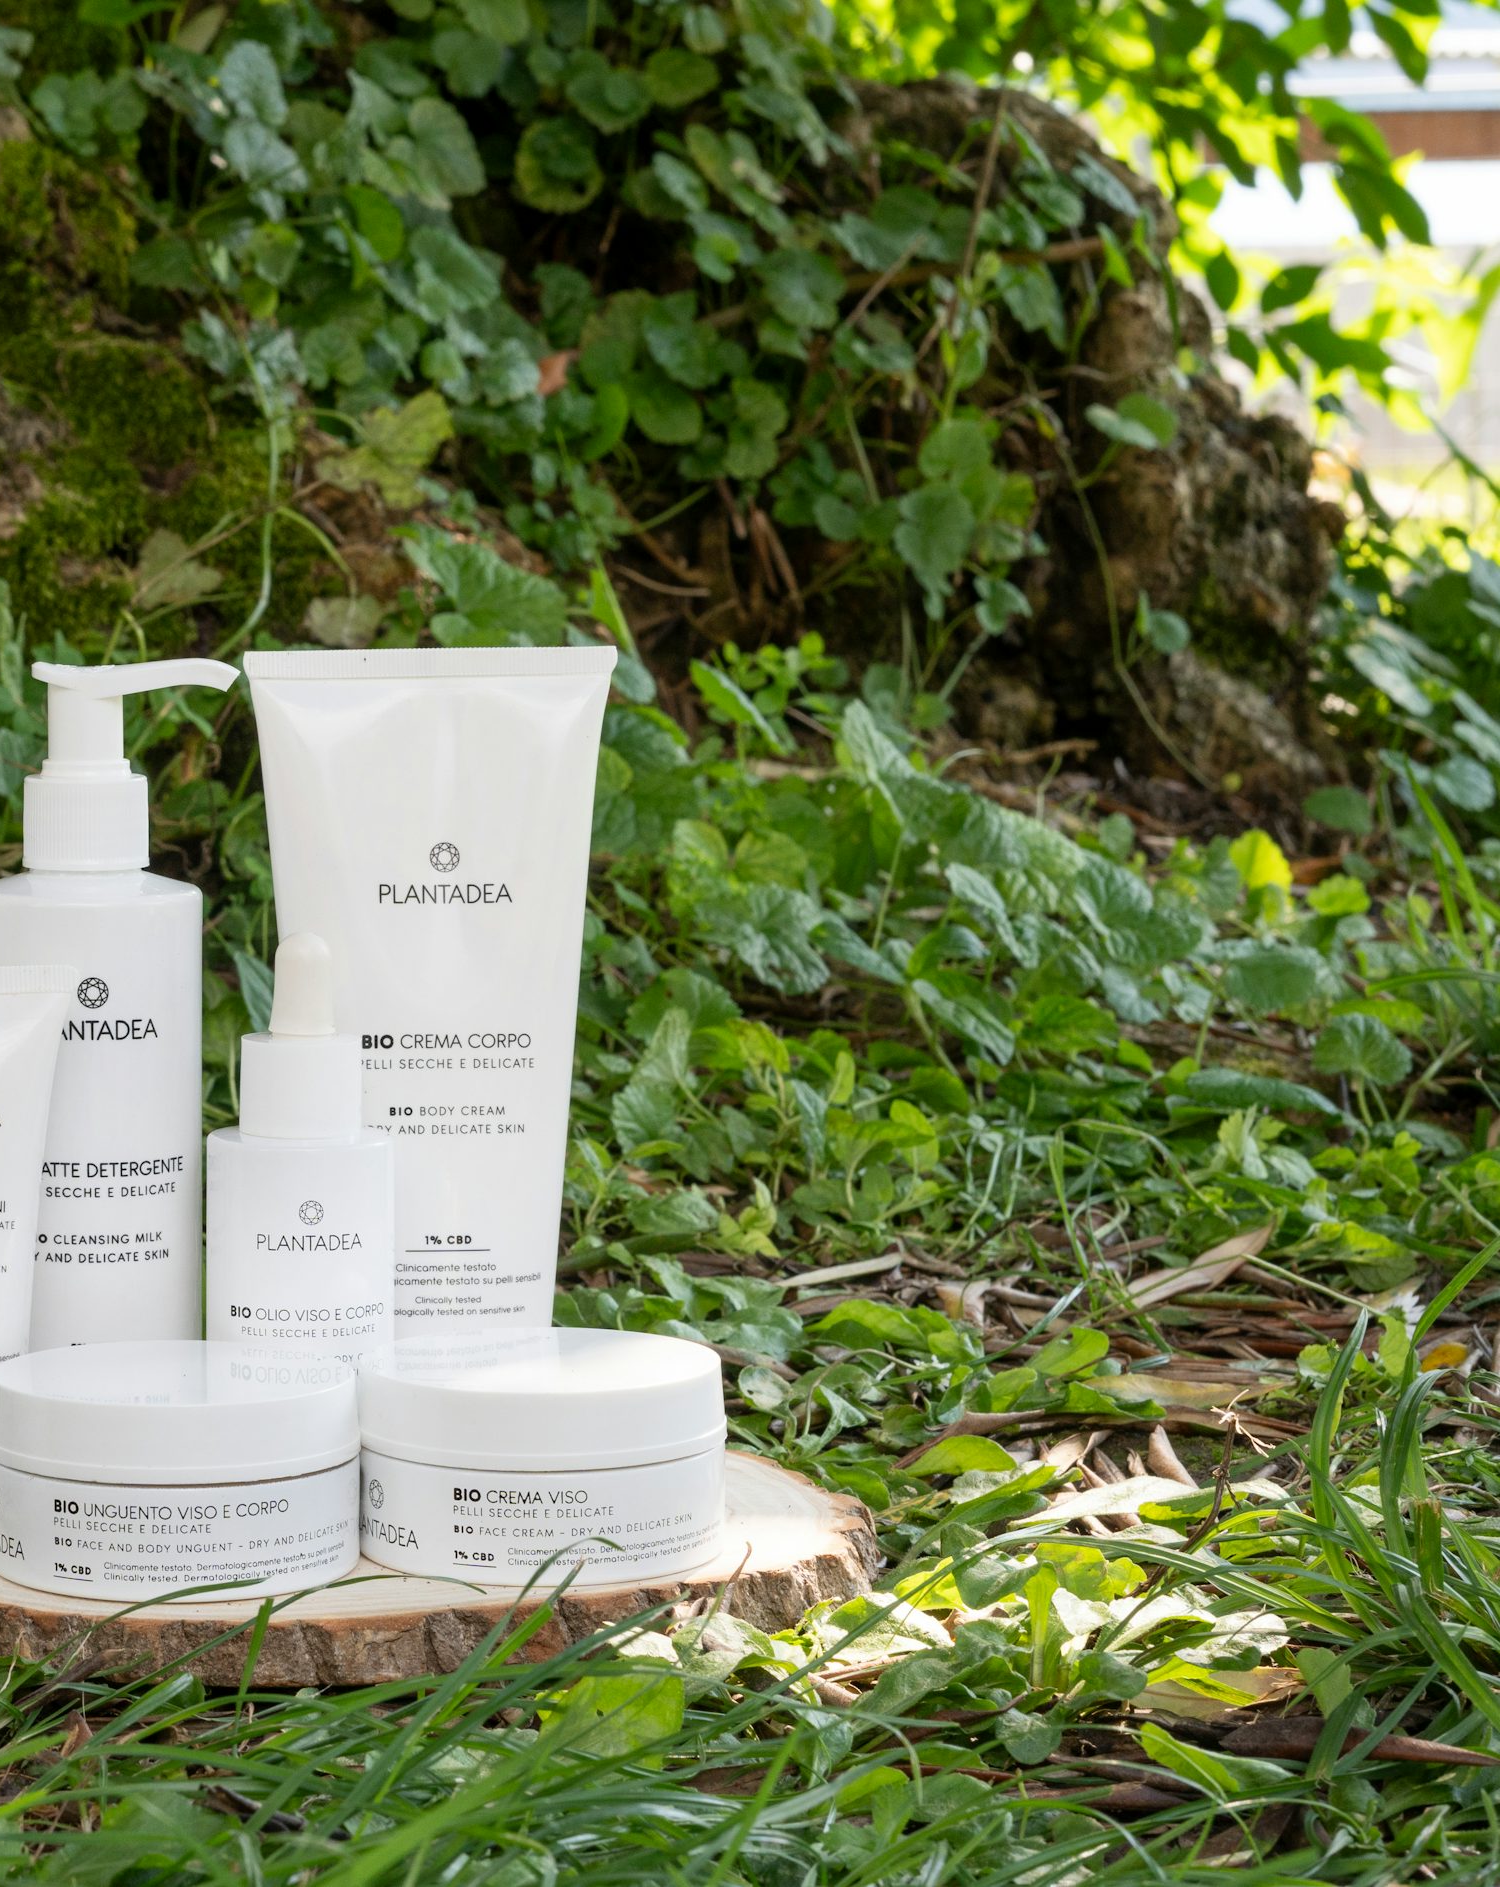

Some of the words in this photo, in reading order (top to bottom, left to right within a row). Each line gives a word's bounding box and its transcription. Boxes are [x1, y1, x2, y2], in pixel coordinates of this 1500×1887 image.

[379, 884, 512, 904] PLANTADEA
[362, 1035, 394, 1049] BIO
[400, 1034, 462, 1049] CREMA
[468, 1033, 531, 1049] CORPO
[399, 1058, 453, 1070] SECCHE
[460, 1059, 466, 1068] E
[473, 1058, 535, 1069] DELICATE
[389, 1107, 413, 1116] BIO
[419, 1106, 455, 1116] BODY
[461, 1106, 505, 1115] CREAM
[398, 1125, 425, 1135] AND
[432, 1125, 491, 1135] DELICATE
[497, 1124, 525, 1134] SKIN
[42, 1162, 80, 1177] ATTE
[87, 1156, 183, 1178] DETERGENTE
[46, 1187, 100, 1198] SECCHE
[108, 1187, 114, 1197] E
[121, 1182, 176, 1197] DELICATE
[53, 1234, 130, 1245] CLEANSING
[135, 1232, 162, 1243] MILK
[256, 1233, 362, 1251] PLANTADEA
[425, 1236, 442, 1245] 1%
[447, 1235, 472, 1245] CBD
[45, 1253, 72, 1263] AND
[79, 1252, 139, 1263] DELICATE
[144, 1249, 169, 1260] SKIN
[395, 1263, 460, 1273] Clinicamente
[463, 1263, 496, 1272] testato
[446, 1277, 480, 1285] testato
[496, 1275, 513, 1286] pelli
[415, 1296, 453, 1304] Clinically
[231, 1305, 251, 1318] BIO
[255, 1308, 290, 1322] OLIO
[295, 1309, 330, 1322] VISO
[335, 1309, 341, 1320] E
[345, 1302, 384, 1320] CORPO
[437, 1308, 464, 1316] tested
[241, 1326, 267, 1337] PELLI
[272, 1329, 317, 1338] SECCHE
[322, 1329, 327, 1337] E
[332, 1324, 376, 1337] DELICATE
[453, 1488, 481, 1501] BIO
[486, 1490, 543, 1505] CREMA
[548, 1490, 588, 1505] VISO
[54, 1499, 79, 1514] BIO
[84, 1503, 172, 1520] UNGUENTO
[177, 1505, 217, 1520] VISO
[223, 1505, 231, 1518] E
[236, 1499, 289, 1517] CORPO
[453, 1505, 483, 1517] PELLI
[489, 1509, 538, 1518] SECCHE
[544, 1509, 550, 1518] E
[557, 1506, 615, 1518] DELICATE
[53, 1517, 81, 1530] PELLI
[86, 1523, 133, 1533] SECCHE
[140, 1525, 145, 1533] E
[152, 1524, 211, 1534] DELICATE
[454, 1525, 474, 1534] BIO
[479, 1527, 507, 1537] FACE
[512, 1528, 554, 1537] CREAM
[571, 1527, 594, 1537] DRY
[598, 1525, 621, 1535] AND
[626, 1518, 671, 1533] DELICATE
[674, 1513, 692, 1525] SKIN
[54, 1537, 72, 1547] BIO
[77, 1540, 103, 1551] FACE
[109, 1543, 132, 1553] AND
[138, 1544, 171, 1553] BODY
[176, 1543, 233, 1553] UNGUENT
[249, 1539, 270, 1549] DRY
[274, 1536, 294, 1546] AND
[298, 1525, 334, 1542] DELICATE
[336, 1520, 349, 1532] SKIN
[454, 1550, 468, 1560] 1%
[472, 1552, 494, 1561] CBD
[54, 1563, 67, 1572] 1%
[71, 1565, 91, 1575] CBD
[104, 1562, 158, 1572] Clinicamente
[197, 1558, 281, 1571] Dermatologicamente
[104, 1573, 144, 1583] Clinically
[184, 1569, 261, 1582] Dermatologically
[263, 1567, 288, 1576] tested
